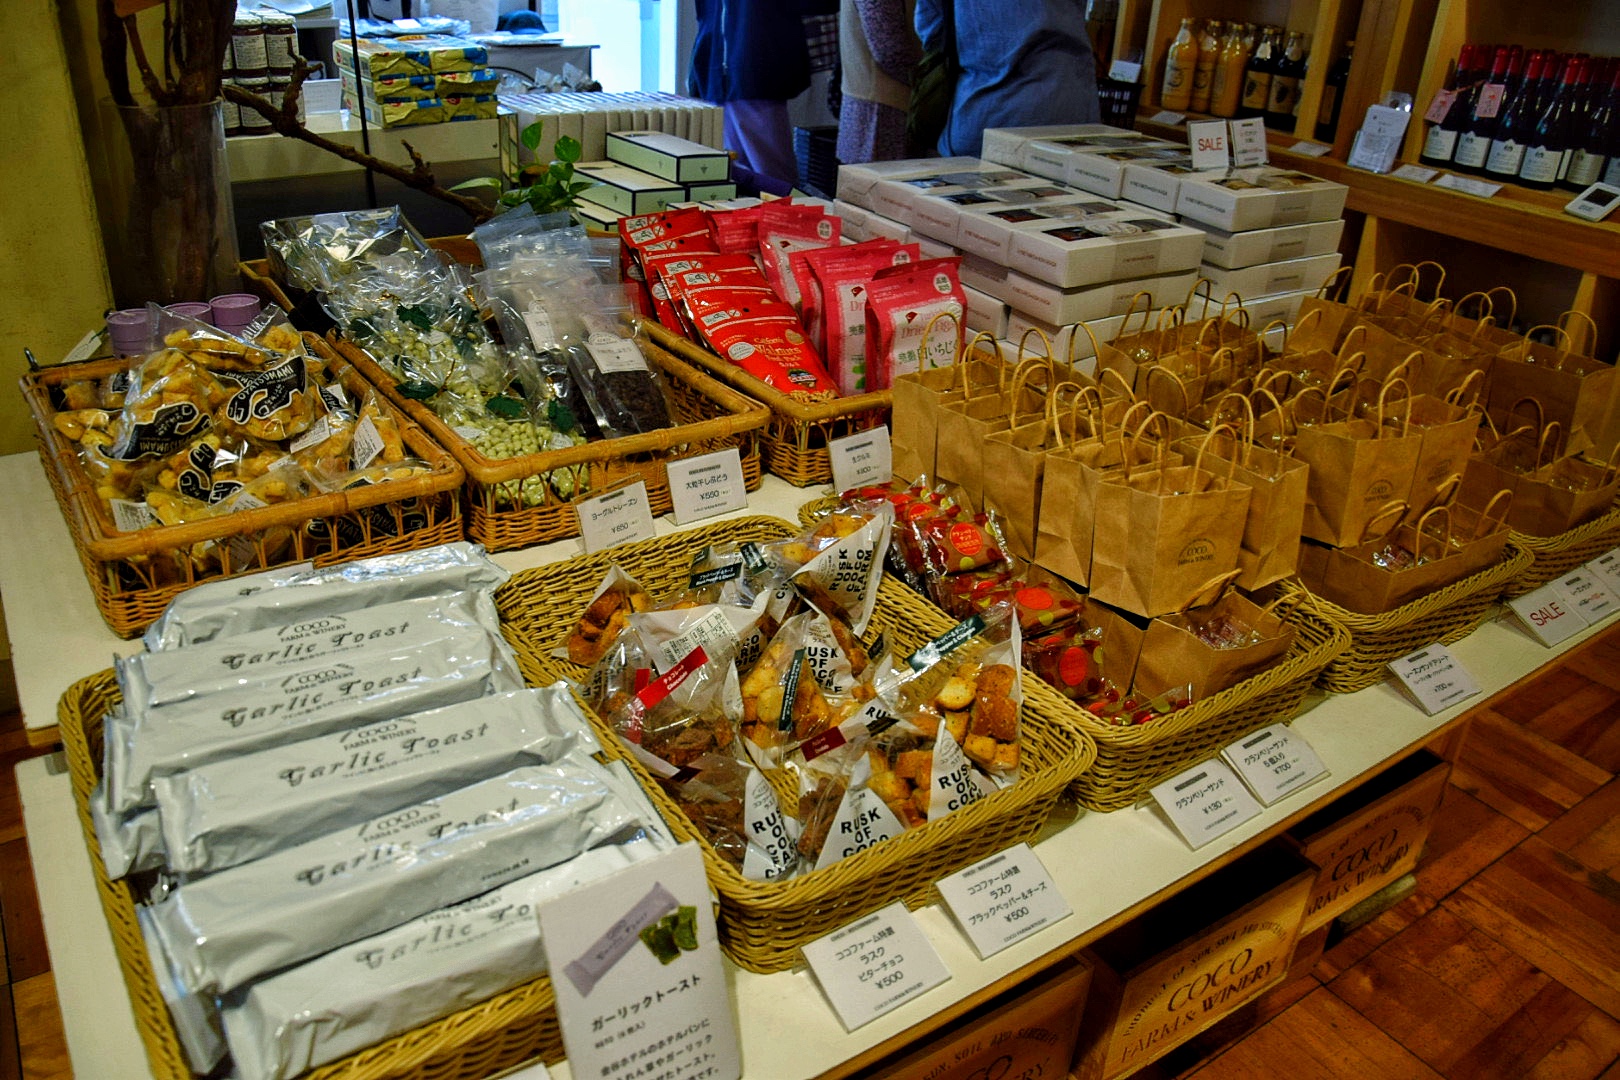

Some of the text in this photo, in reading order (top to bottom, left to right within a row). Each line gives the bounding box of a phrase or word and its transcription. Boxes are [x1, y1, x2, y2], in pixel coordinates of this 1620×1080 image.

[1198, 136, 1223, 152] SALE
[237, 364, 294, 400] OYATSUMAMI
[685, 473, 728, 491] 大粒干しぶどう
[591, 497, 638, 521] ヨーグルトレーズン
[829, 549, 848, 591] RUSK
[843, 561, 854, 582] OF
[846, 549, 865, 592] COCO
[294, 619, 329, 633] COCO
[1530, 601, 1566, 627] SALE
[222, 643, 318, 670] Garlic
[331, 621, 410, 648] Toast
[280, 633, 304, 642] FARM
[312, 624, 348, 636] WINERY
[807, 646, 839, 658] USK
[298, 669, 337, 684] COCO
[222, 692, 324, 727] Garlic
[338, 666, 422, 697] Toast
[865, 706, 892, 720] RU
[357, 723, 399, 739] COCO
[279, 750, 386, 787] Garlic
[402, 722, 489, 754] Toast
[1244, 737, 1289, 766] クランベリーサンド
[938, 764, 969, 790] RUS
[1273, 763, 1291, 775] ¥700
[1175, 778, 1225, 810] クランベリーサンド
[377, 809, 421, 831] COCO
[752, 806, 781, 834] RU
[841, 808, 881, 834] RUSK
[855, 826, 872, 844] OF
[295, 840, 412, 886] Garlic
[967, 865, 1021, 896] ココファーム特選
[989, 884, 1012, 900] ラスク
[968, 881, 1048, 926] ブラックペッパー&チーズ
[1003, 906, 1029, 924] ¥500
[355, 923, 473, 970] Garlic
[835, 926, 895, 961] ココファーム特選
[860, 946, 886, 965] ラスク
[858, 955, 905, 983] ビターチョコ
[874, 970, 905, 990] ¥500
[1168, 948, 1253, 1012] COCO
[592, 974, 701, 1032] ガーリックトースト
[1122, 1016, 1180, 1063] FARM
[1202, 956, 1278, 1012] WINERY
[955, 1041, 983, 1063] SOIL
